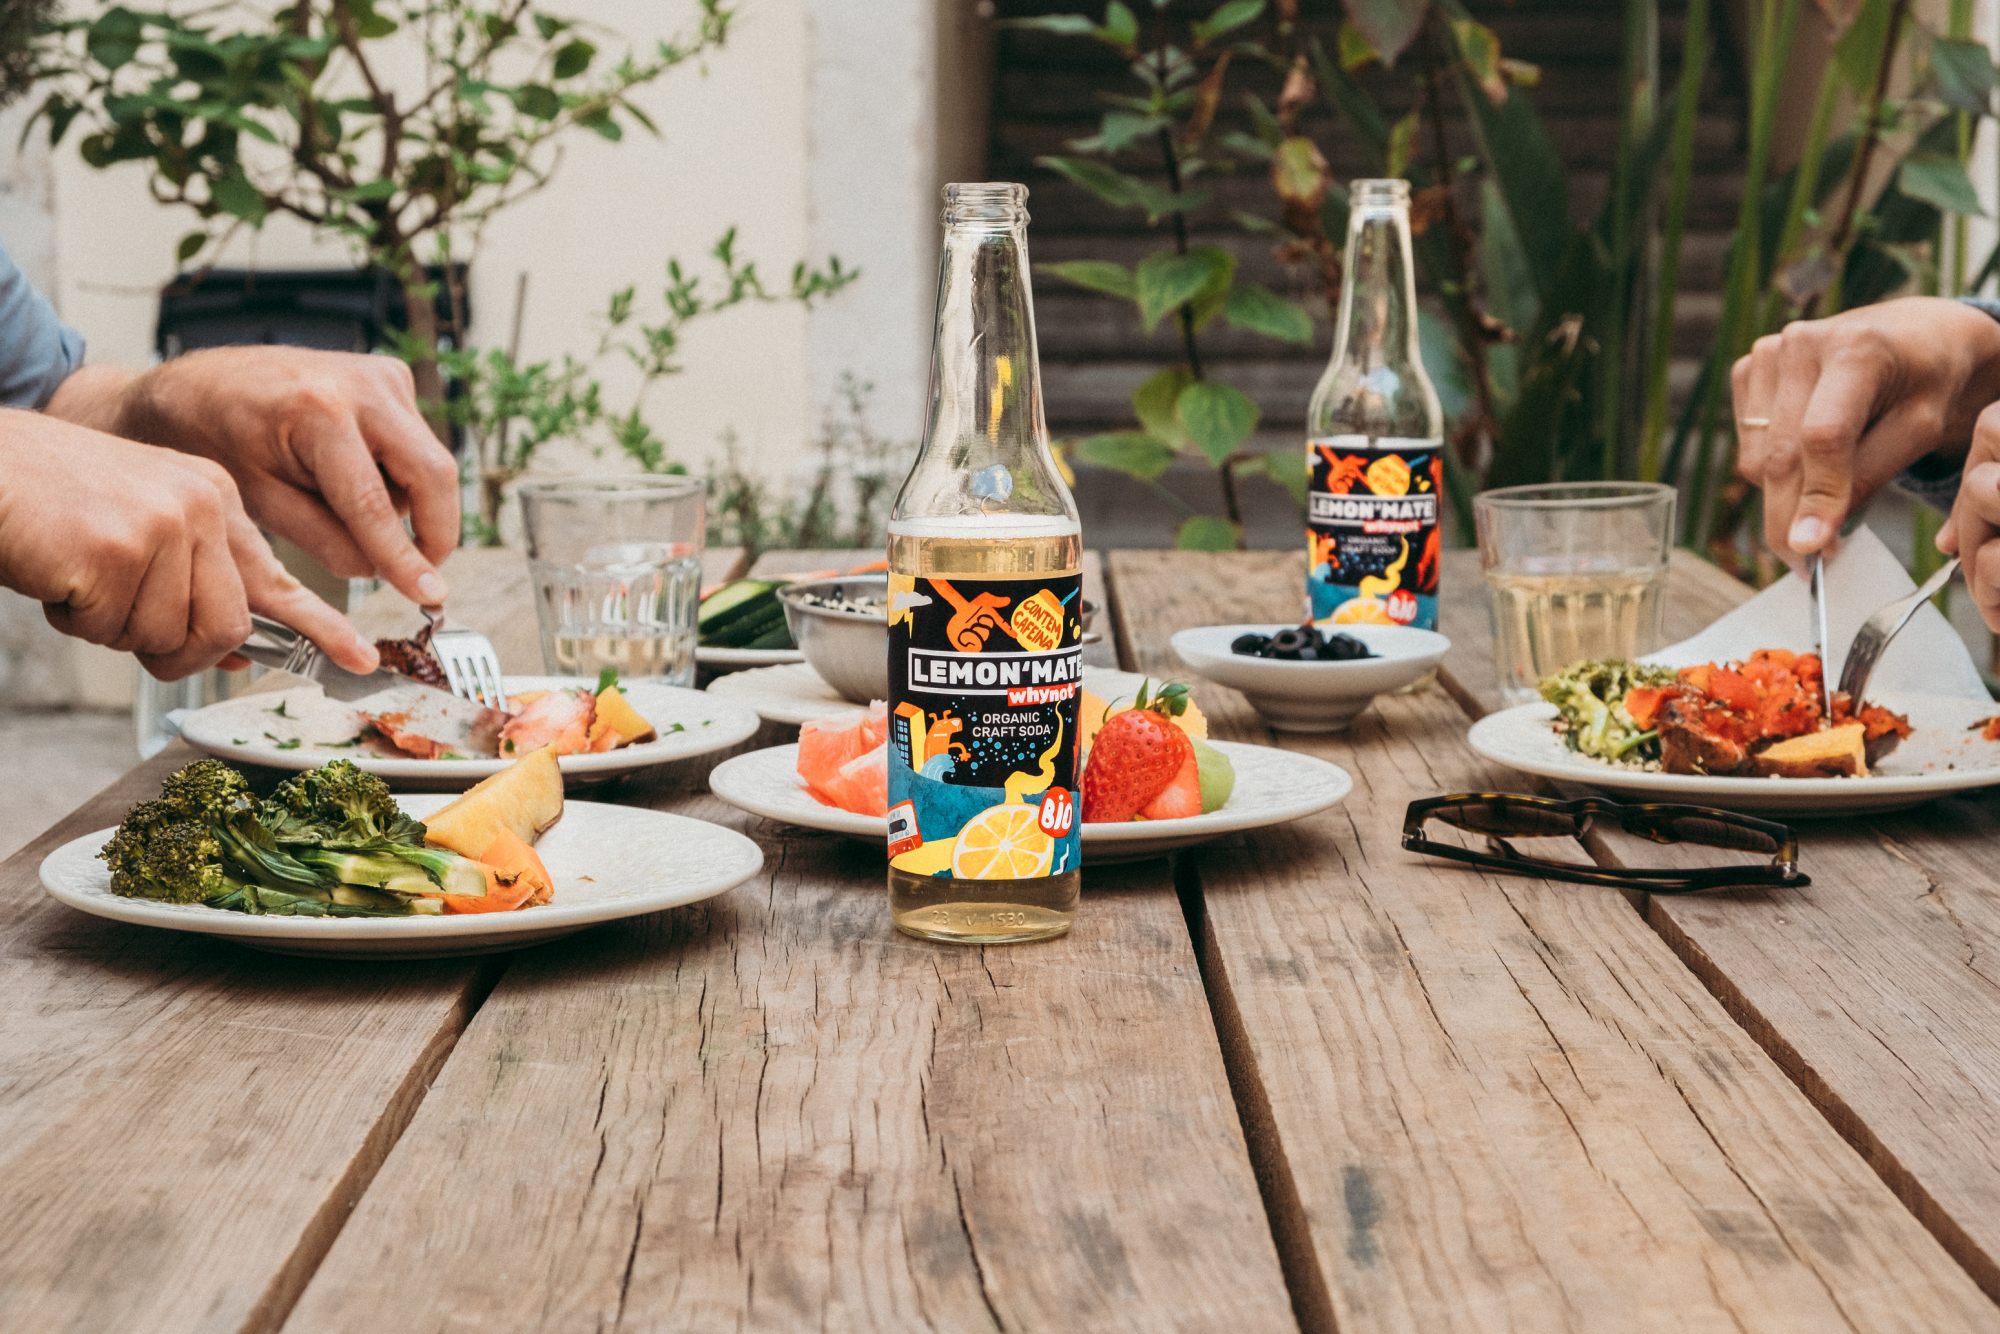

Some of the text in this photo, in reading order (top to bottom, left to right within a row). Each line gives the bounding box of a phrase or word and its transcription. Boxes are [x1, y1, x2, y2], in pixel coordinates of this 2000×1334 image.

[1009, 686, 1074, 704] whynot
[982, 712, 1040, 724] ORGANIC
[972, 724, 1051, 738] CRAFT SODA
